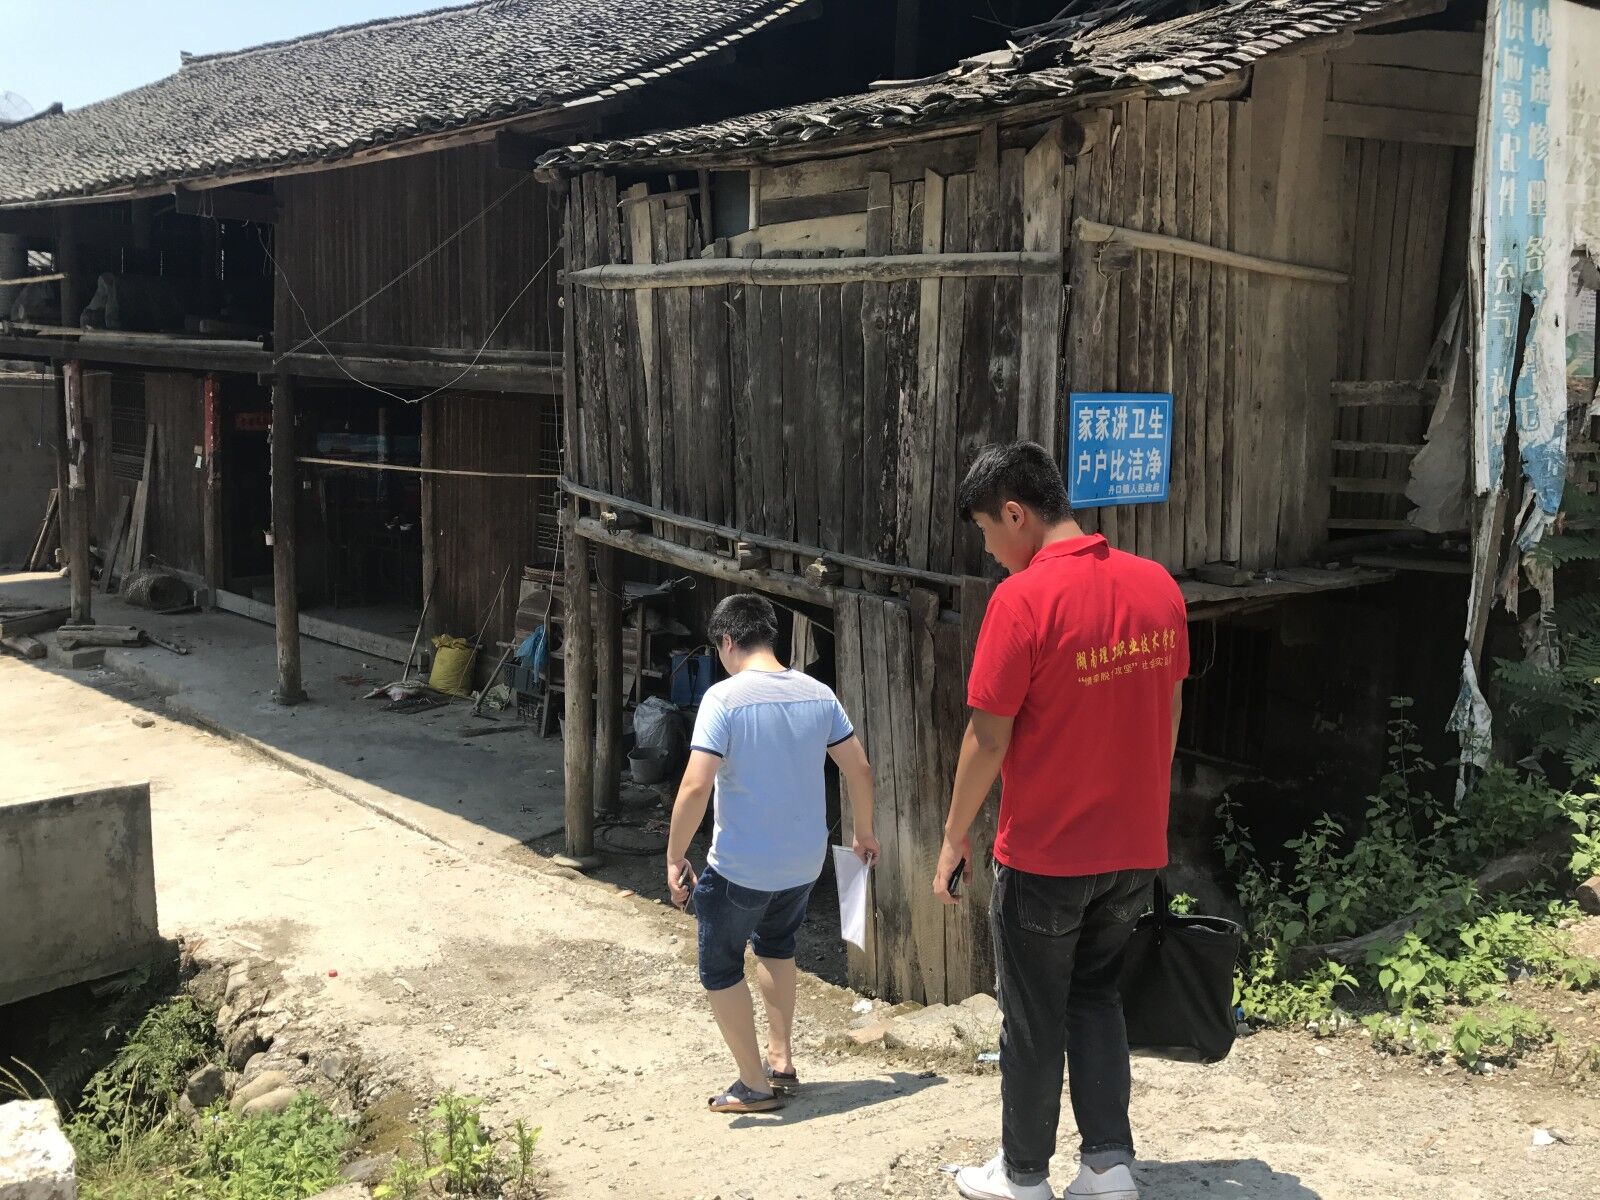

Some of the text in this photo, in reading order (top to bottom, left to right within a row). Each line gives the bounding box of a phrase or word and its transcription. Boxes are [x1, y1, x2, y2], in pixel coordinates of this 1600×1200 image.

[1078, 406, 1164, 442] 家家讲卫生
[1076, 447, 1162, 485] 户户比洁净
[1108, 482, 1160, 495] 丹口镇人民政府
